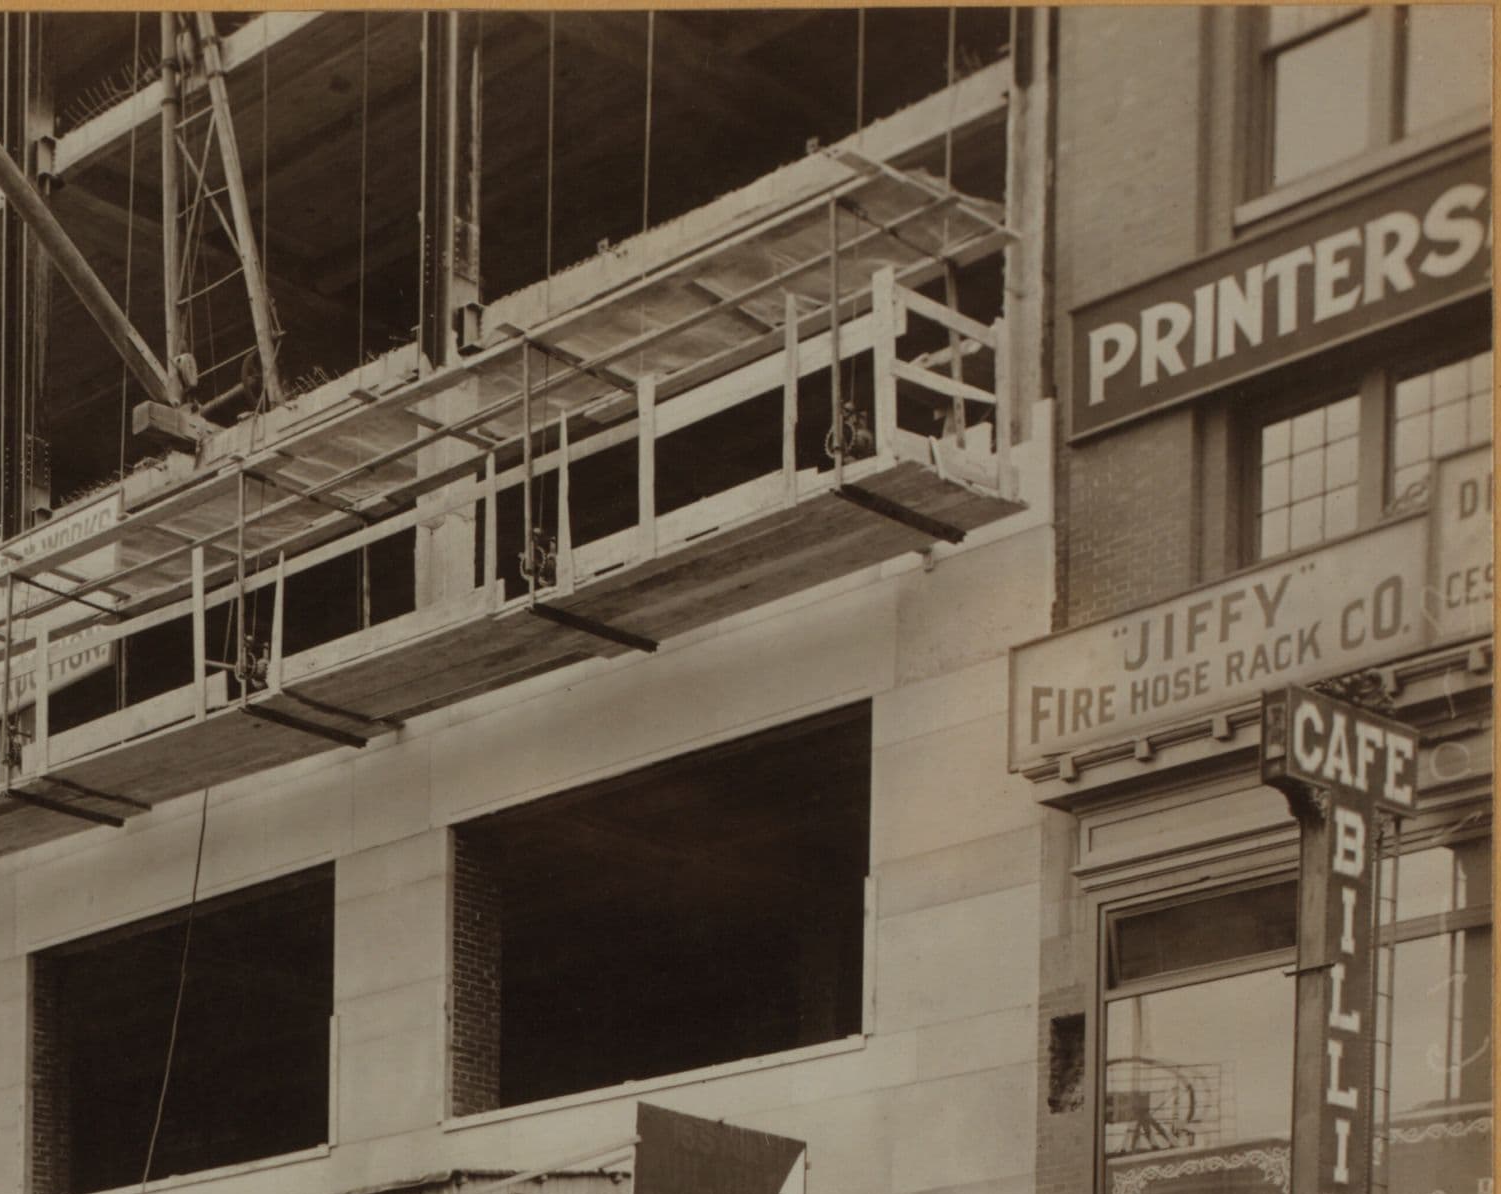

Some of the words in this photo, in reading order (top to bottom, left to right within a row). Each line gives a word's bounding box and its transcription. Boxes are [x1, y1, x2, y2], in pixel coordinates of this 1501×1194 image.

[1088, 184, 1486, 406] PRINTERS
[1030, 684, 1116, 745] FIRE
[1129, 659, 1211, 716] HOSE
[1225, 620, 1323, 688] RACK
[1339, 574, 1411, 652] CO.
[1292, 700, 1413, 806] CAFE
